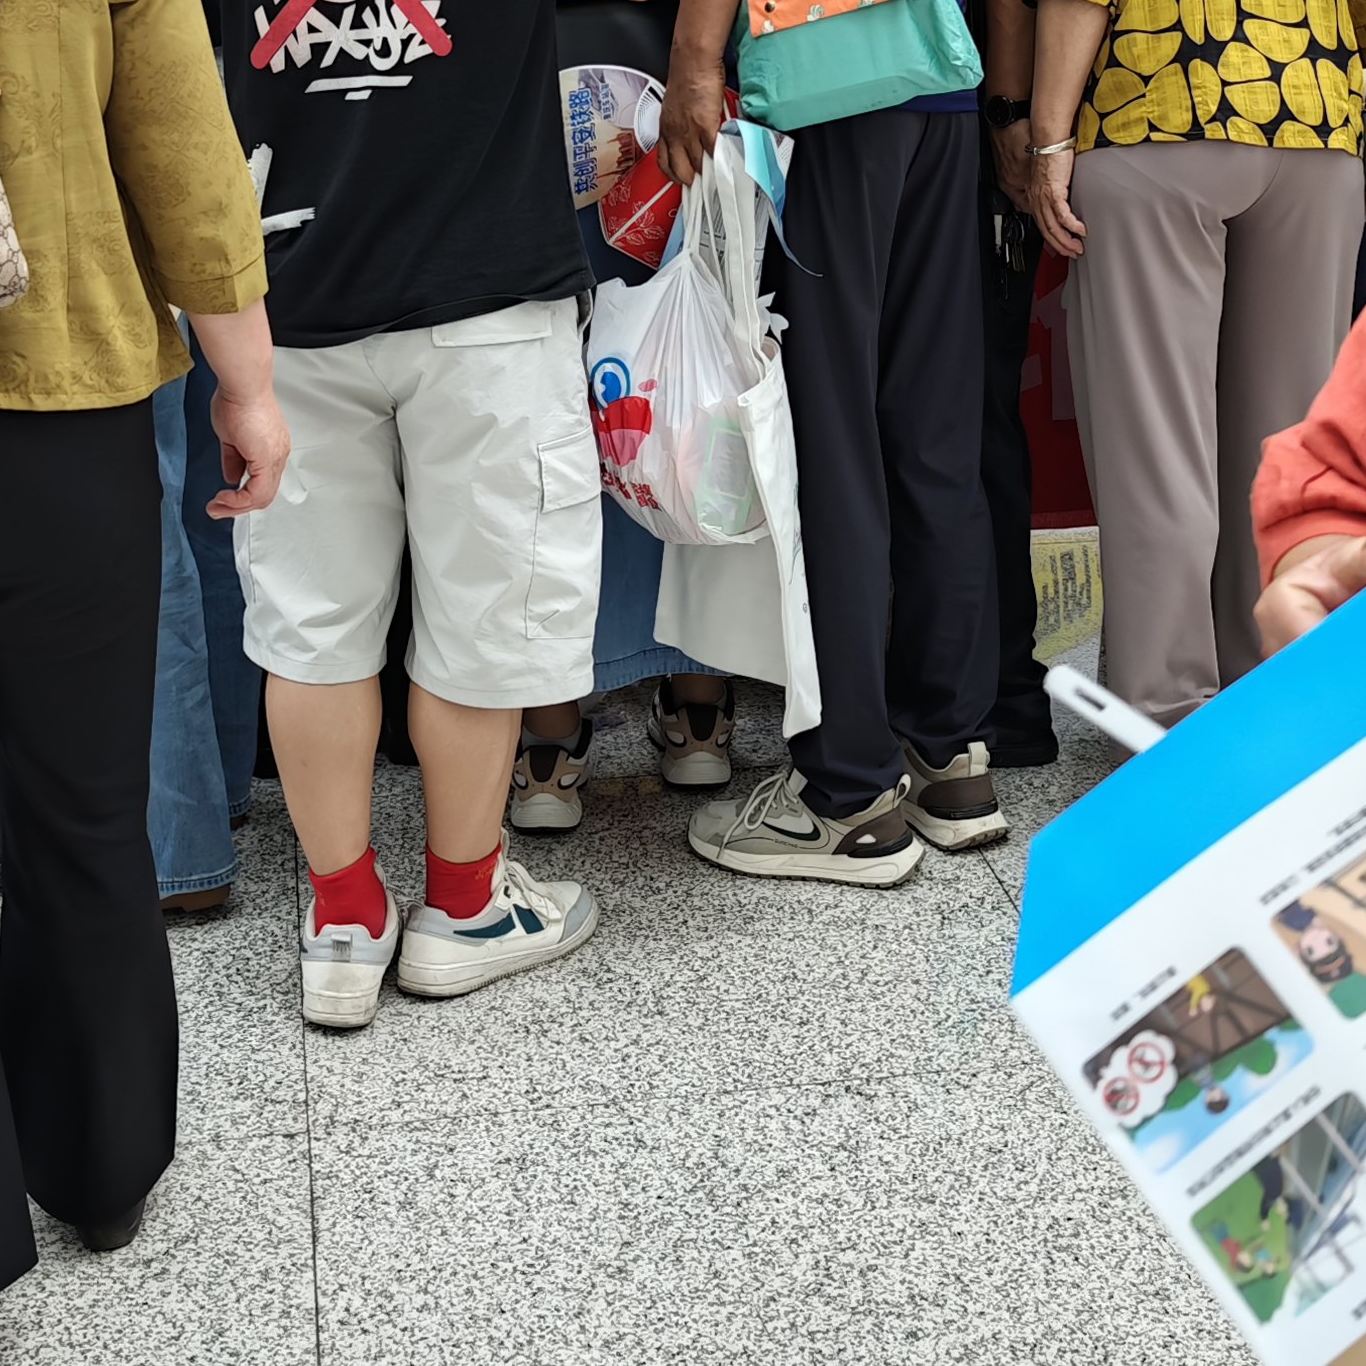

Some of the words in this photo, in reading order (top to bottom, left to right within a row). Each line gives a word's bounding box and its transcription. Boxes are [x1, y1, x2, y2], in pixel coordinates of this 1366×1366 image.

[571, 86, 598, 197] 共创平安铁路
